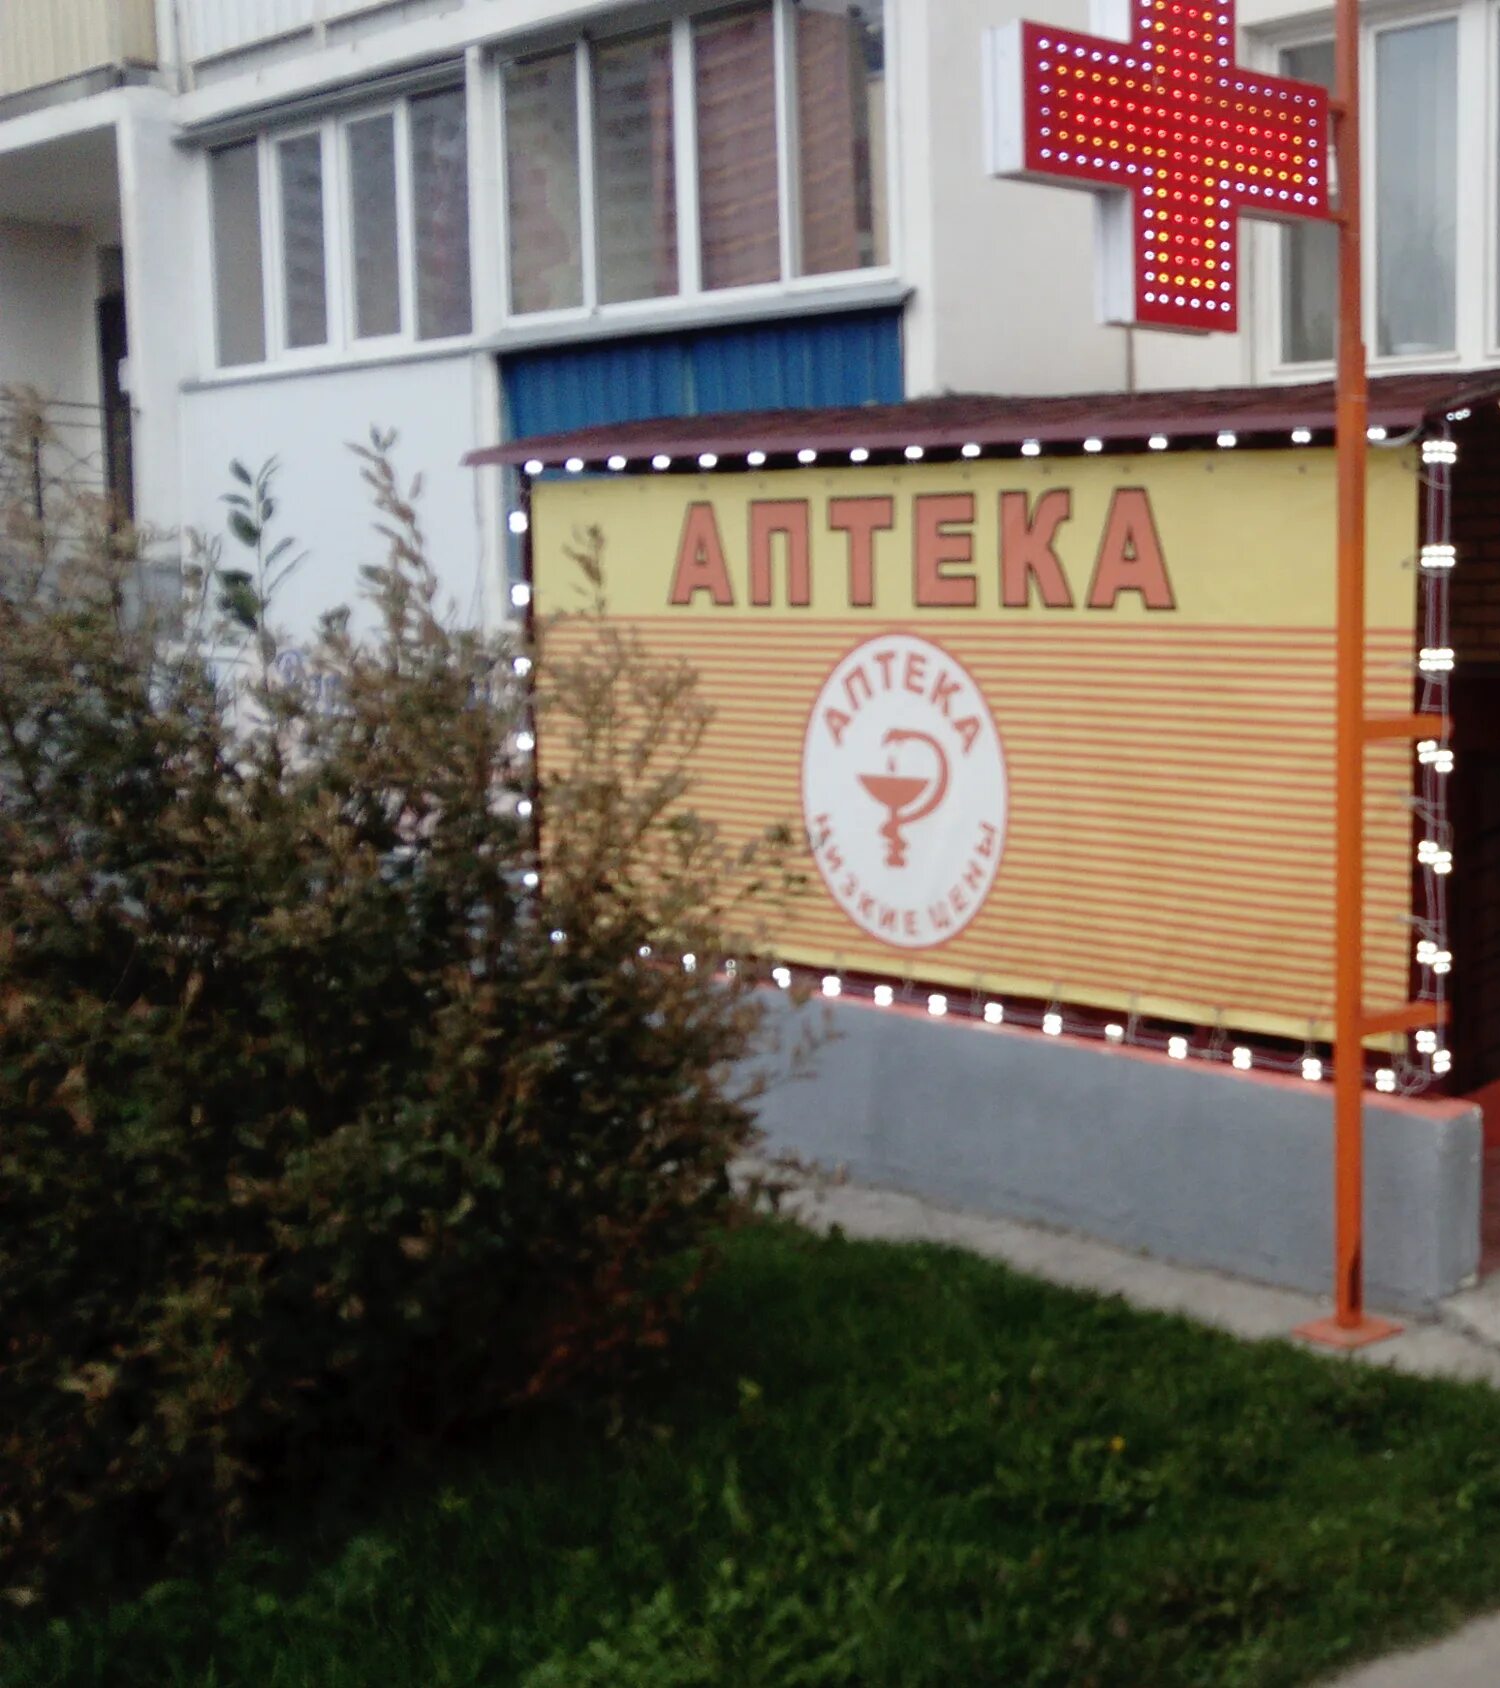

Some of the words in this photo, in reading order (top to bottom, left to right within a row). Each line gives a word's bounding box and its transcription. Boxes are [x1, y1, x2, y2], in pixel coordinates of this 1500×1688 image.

[669, 486, 1177, 611] АПТЕКА
[823, 651, 982, 756] АПТЕКА
[815, 813, 918, 935] НИЗКИЕ
[926, 820, 997, 930] ЦЕНЫ
